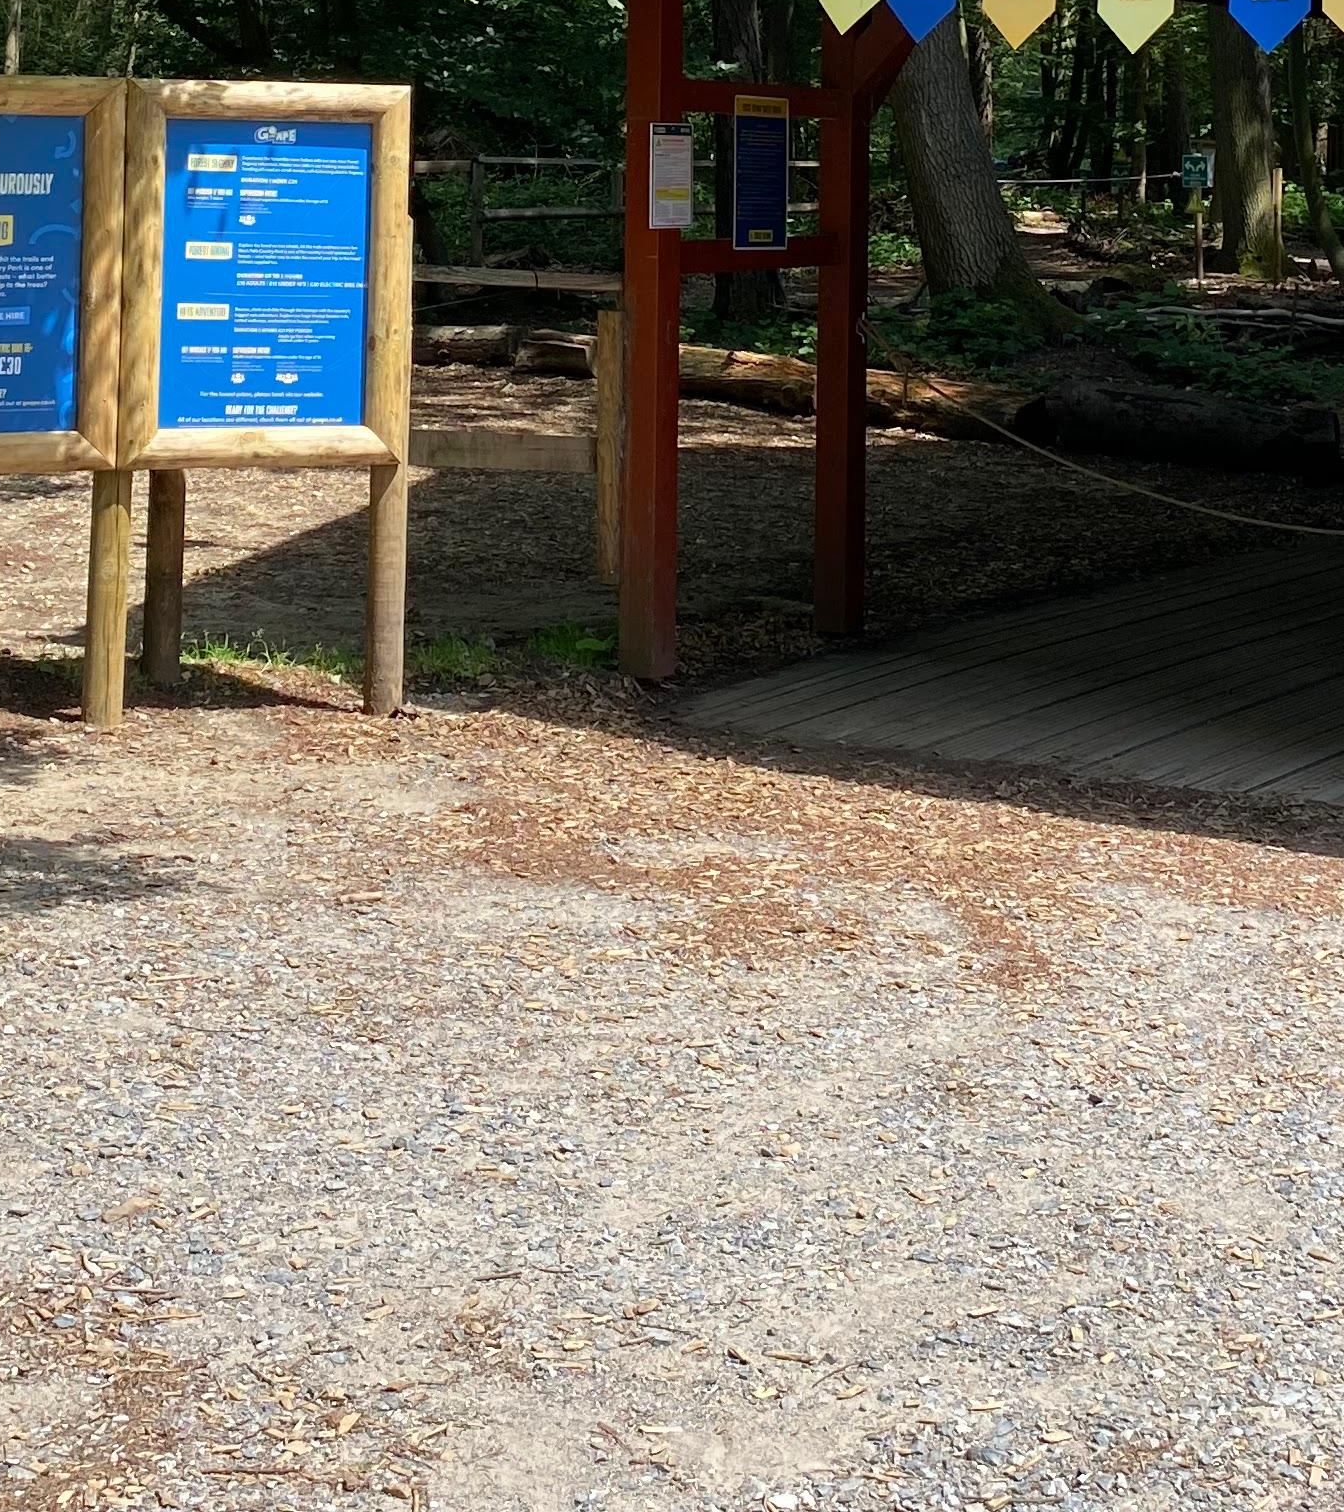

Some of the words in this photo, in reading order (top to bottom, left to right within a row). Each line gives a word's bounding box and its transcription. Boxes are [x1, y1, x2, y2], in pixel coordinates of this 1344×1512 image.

[276, 128, 296, 143] APE
[5, 312, 25, 320] HIRE
[255, 405, 265, 415] THE
